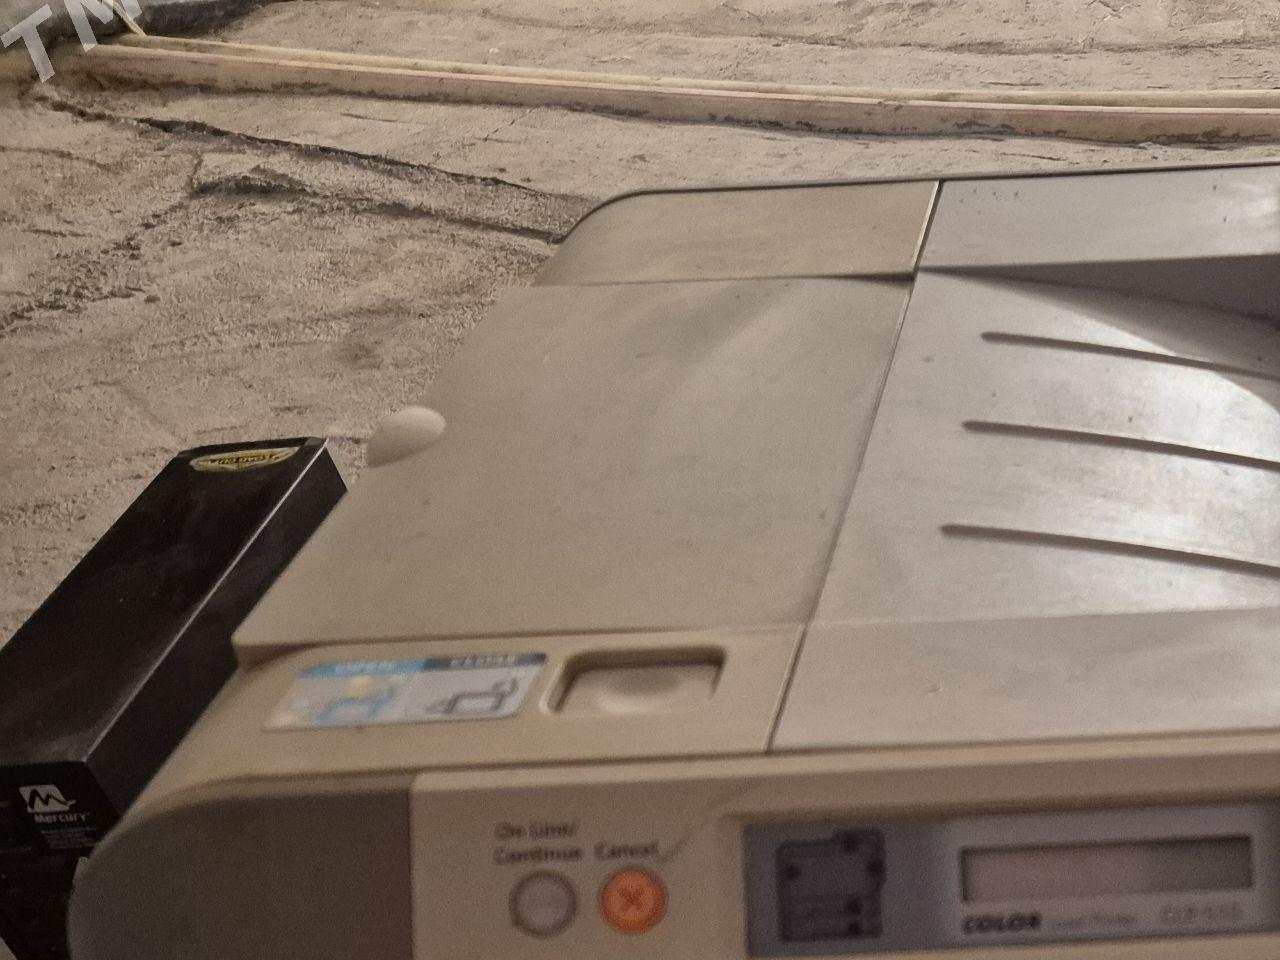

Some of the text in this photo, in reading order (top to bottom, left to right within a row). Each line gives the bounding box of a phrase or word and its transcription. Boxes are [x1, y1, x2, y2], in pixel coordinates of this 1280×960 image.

[494, 845, 583, 865] Continue
[594, 841, 658, 861] Cancel
[962, 911, 1042, 935] COLOR
